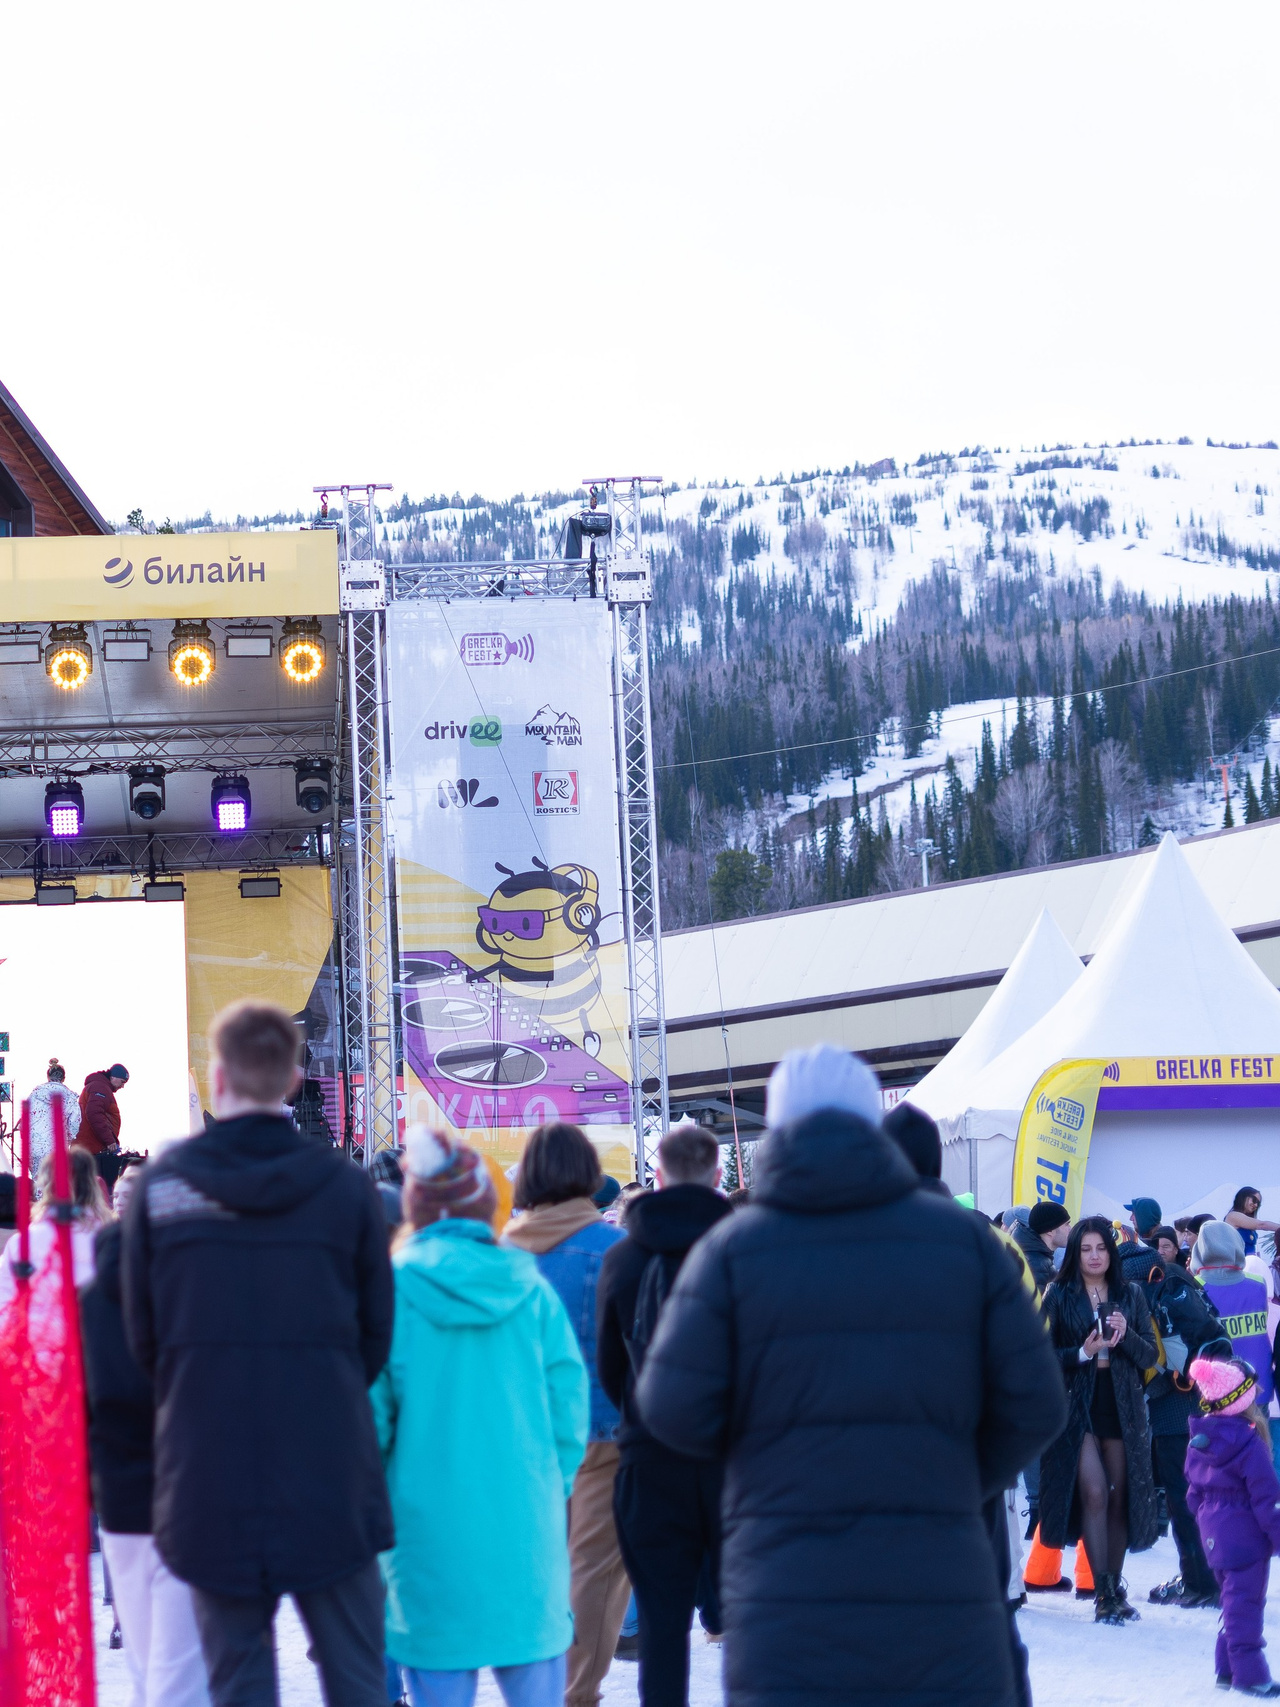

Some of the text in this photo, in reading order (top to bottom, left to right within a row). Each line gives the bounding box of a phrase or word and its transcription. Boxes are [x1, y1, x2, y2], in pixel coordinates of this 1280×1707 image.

[144, 556, 266, 586] билайн
[467, 636, 503, 649] GRELKA
[468, 650, 491, 661] FEST
[424, 720, 503, 741] drivee
[525, 725, 581, 736] MOUNTAIN
[557, 735, 582, 746] MAN
[536, 806, 578, 814] ROSTIC'S
[1156, 1057, 1274, 1079] GRELKA FEST
